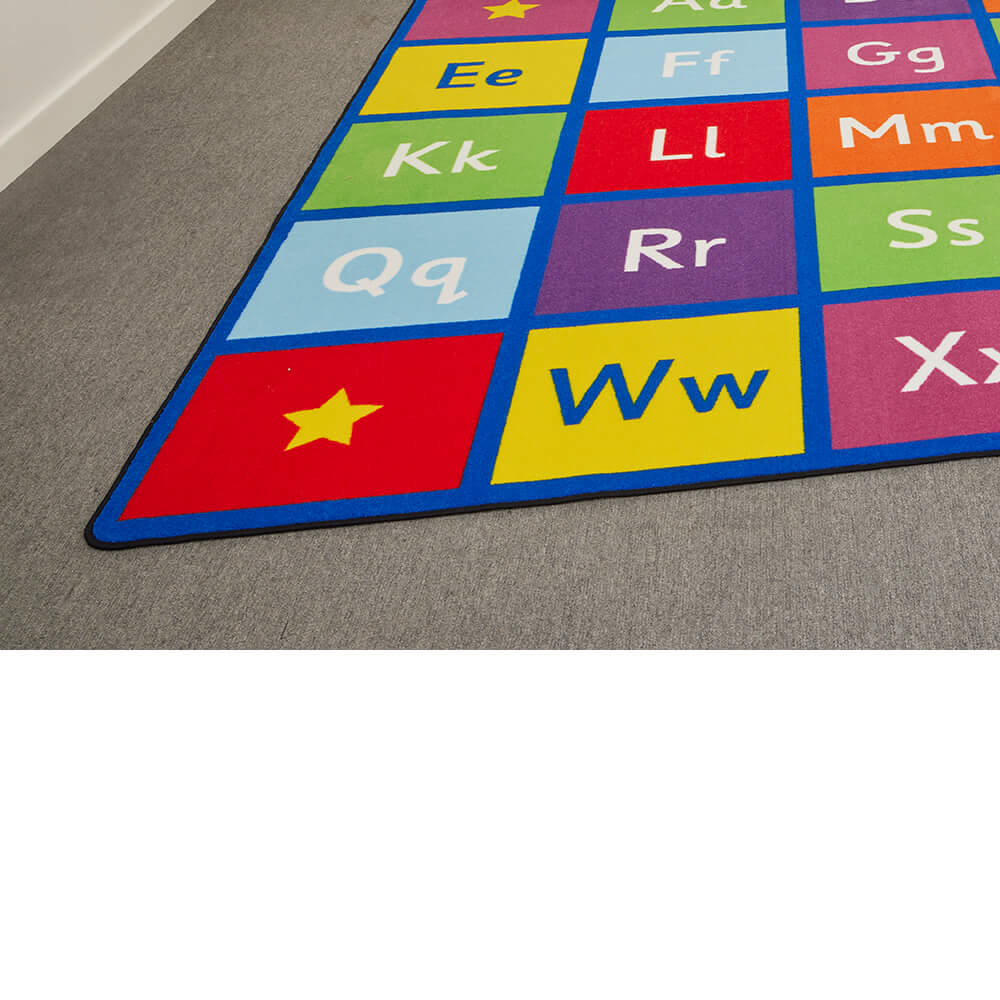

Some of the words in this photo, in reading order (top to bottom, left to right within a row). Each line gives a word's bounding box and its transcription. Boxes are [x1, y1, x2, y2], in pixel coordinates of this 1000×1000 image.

[436, 62, 522, 88] Ee
[662, 50, 734, 77] Ff
[848, 42, 944, 73] Gg
[651, 126, 725, 161] Ll
[840, 114, 994, 148] Mm
[384, 141, 498, 177] Kk
[888, 209, 984, 248] Ss
[624, 228, 726, 272] Rr
[323, 247, 467, 304] Qq
[550, 359, 769, 426] Ww
